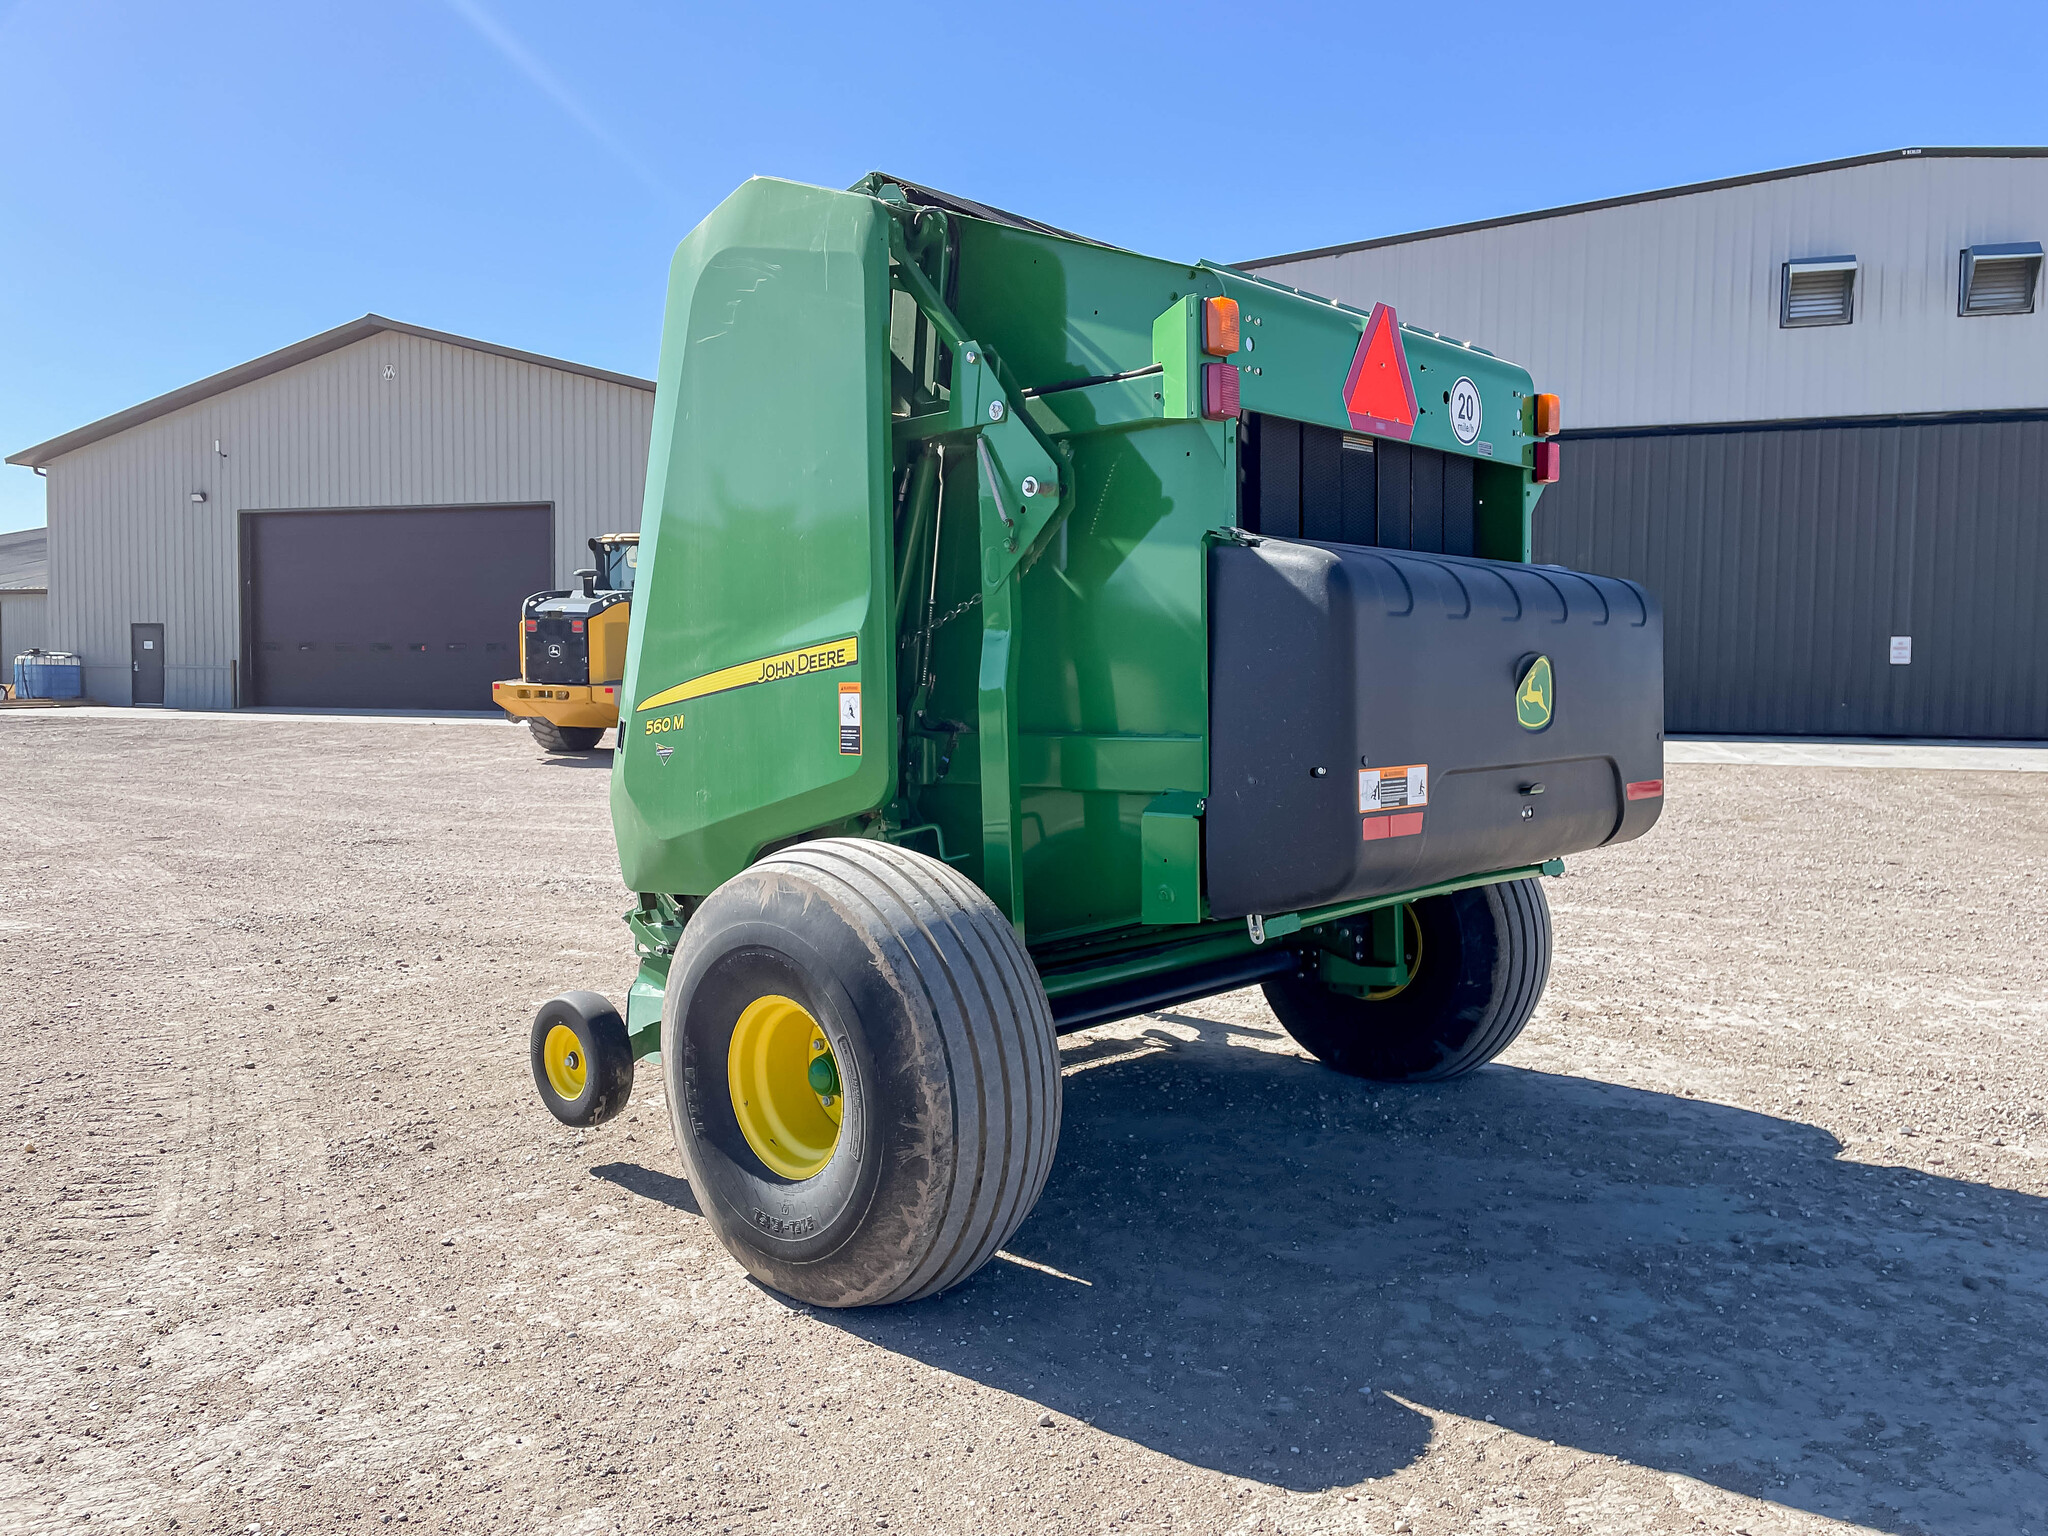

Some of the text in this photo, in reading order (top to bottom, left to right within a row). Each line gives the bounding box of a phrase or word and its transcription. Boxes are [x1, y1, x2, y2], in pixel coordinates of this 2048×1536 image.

[1458, 393, 1473, 421] 20
[758, 648, 846, 681] JOHN DEERE
[645, 713, 685, 736] 560 M
